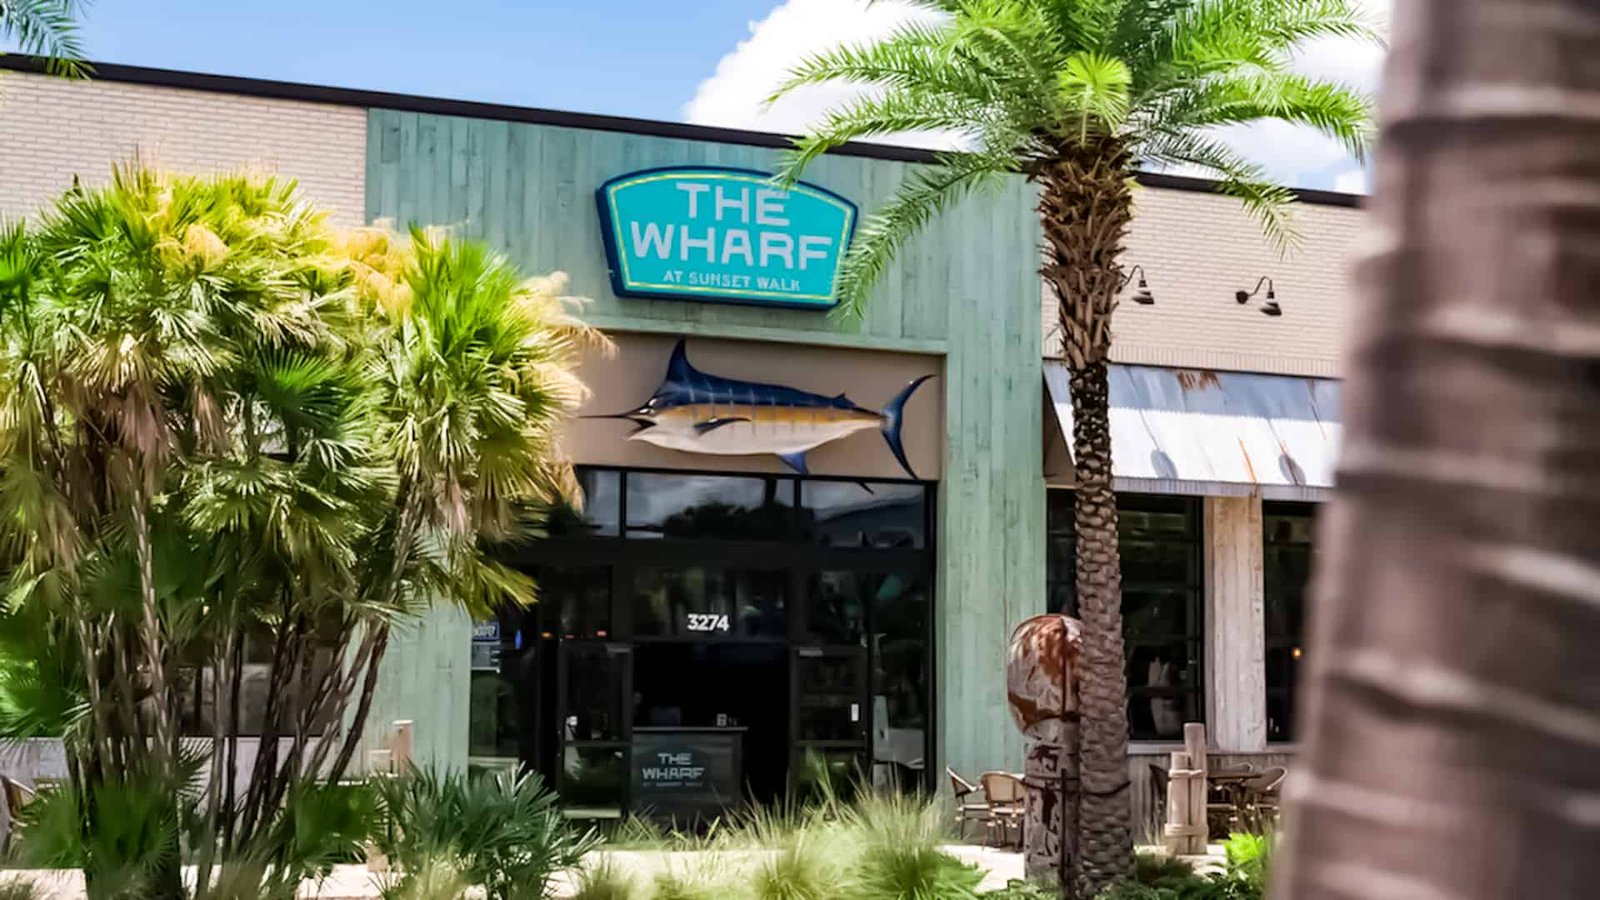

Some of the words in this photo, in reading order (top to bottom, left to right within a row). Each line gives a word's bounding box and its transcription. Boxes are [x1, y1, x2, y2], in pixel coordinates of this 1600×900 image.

[676, 182, 790, 226] THE
[631, 221, 833, 270] WHARF
[663, 270, 682, 282] AT
[688, 270, 751, 288] SUNSET
[757, 276, 800, 291] WALK
[687, 613, 730, 632] 3274
[657, 752, 692, 765] THE
[642, 767, 705, 780] WHARF
